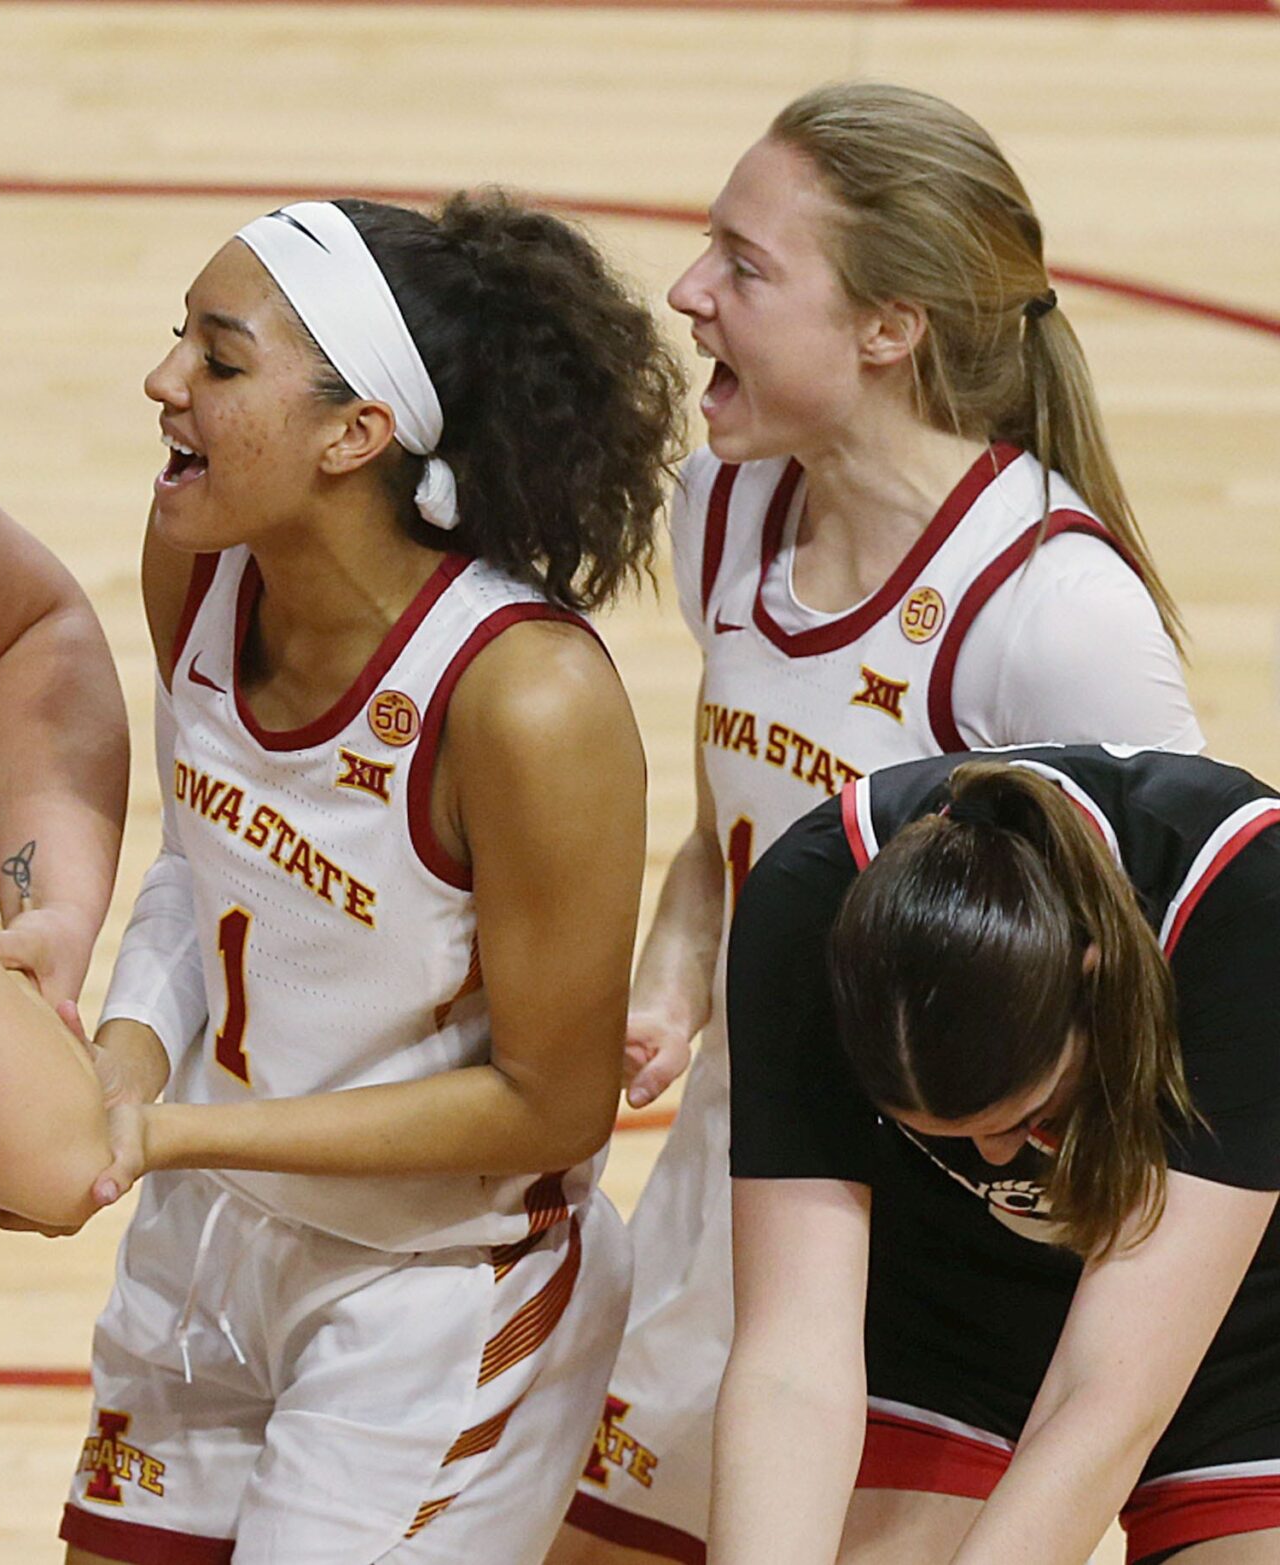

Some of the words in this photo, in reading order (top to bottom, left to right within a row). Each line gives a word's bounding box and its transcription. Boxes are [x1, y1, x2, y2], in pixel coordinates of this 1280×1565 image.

[905, 600, 938, 630] 50
[375, 702, 412, 734] 50
[765, 721, 866, 796] STAT
[174, 759, 245, 834] OWA
[243, 804, 377, 930] STATE
[214, 904, 253, 1088] 1
[77, 1436, 165, 1497] TATE
